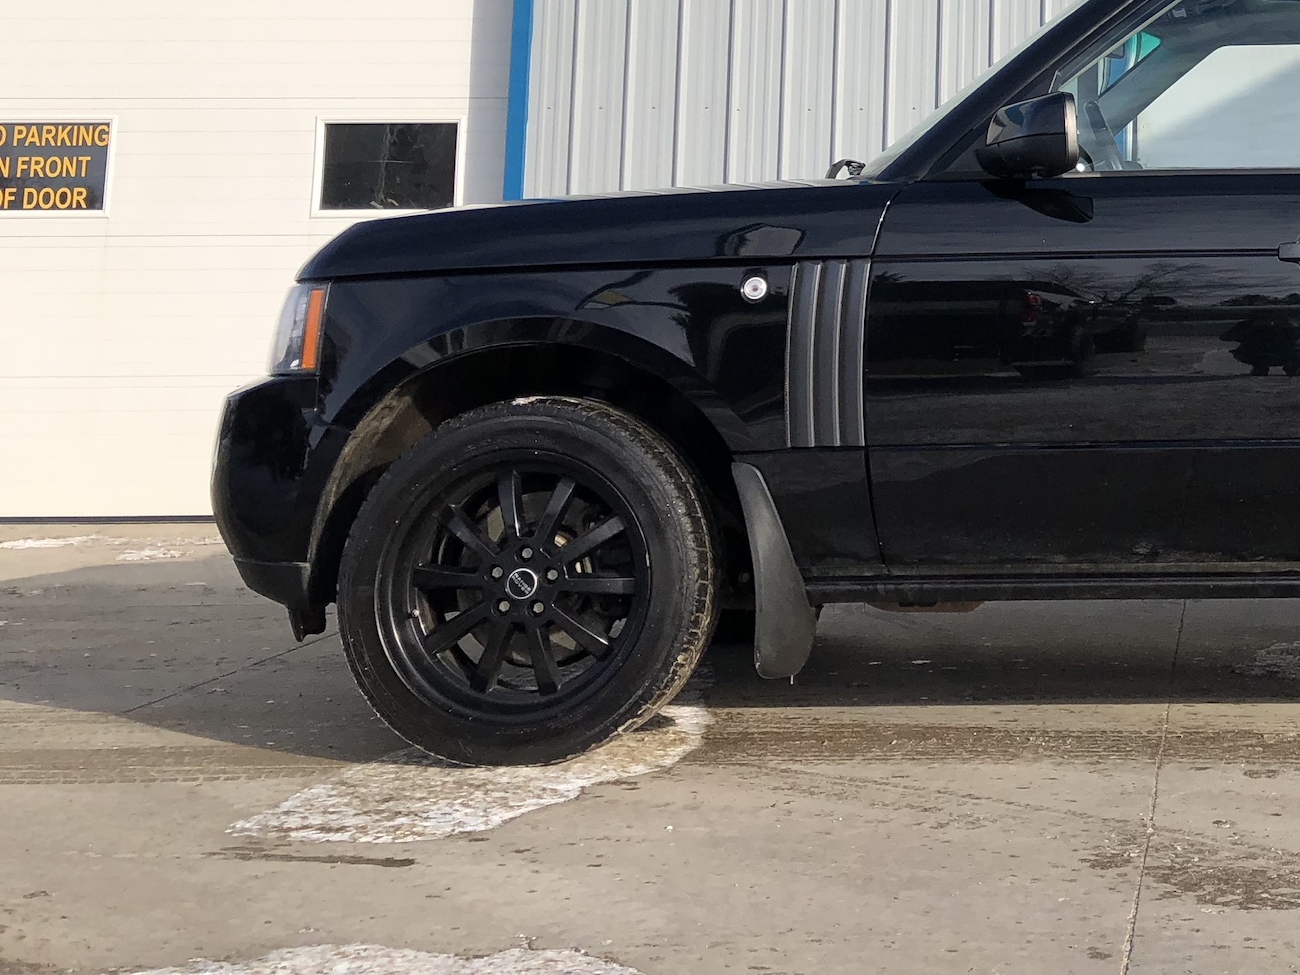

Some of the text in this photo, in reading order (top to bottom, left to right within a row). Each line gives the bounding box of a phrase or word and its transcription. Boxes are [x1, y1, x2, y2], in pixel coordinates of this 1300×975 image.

[12, 124, 110, 147] PARKING
[0, 155, 92, 178] N FRONT
[0, 187, 88, 210] F DOOR
